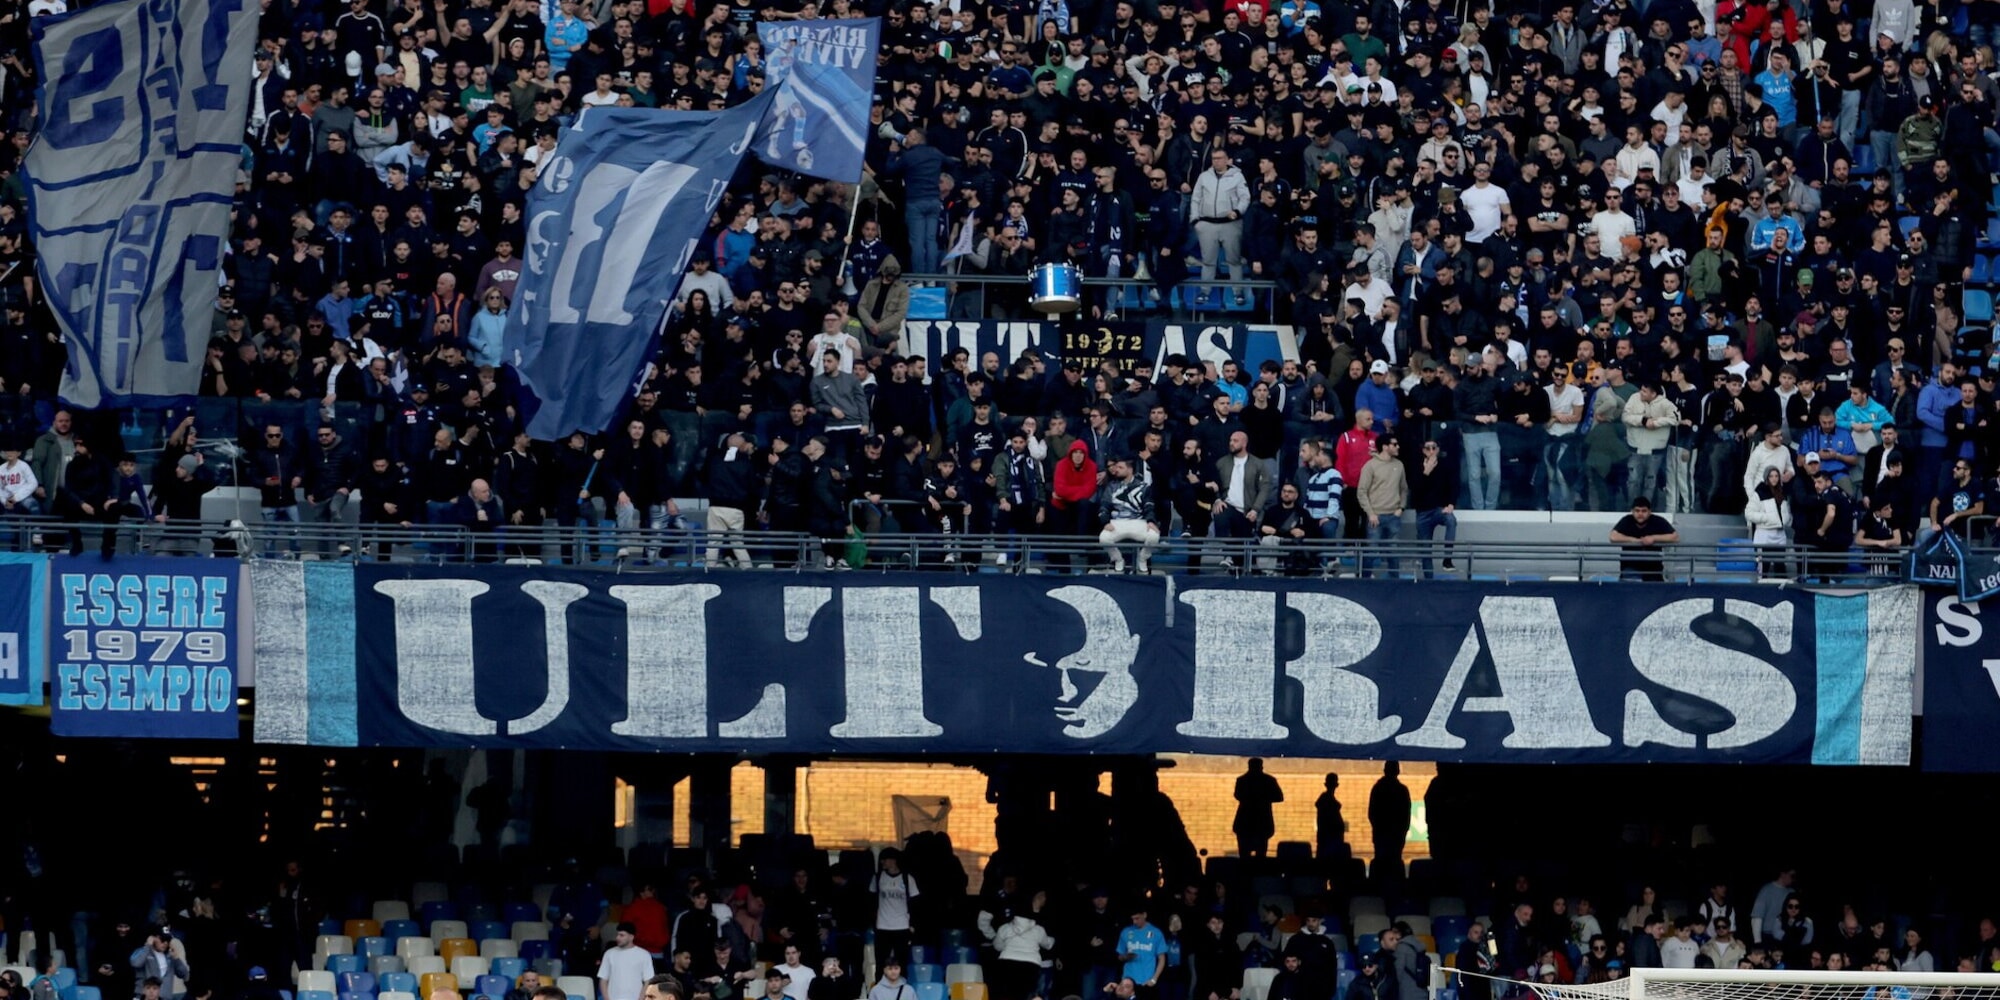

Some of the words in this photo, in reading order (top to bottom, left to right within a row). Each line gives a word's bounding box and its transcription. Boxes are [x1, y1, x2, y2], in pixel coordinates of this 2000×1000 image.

[1066, 333, 1142, 350] 1972
[61, 574, 228, 629] ESSERE
[63, 629, 227, 663] 1979
[58, 663, 232, 713] ESEMPIO
